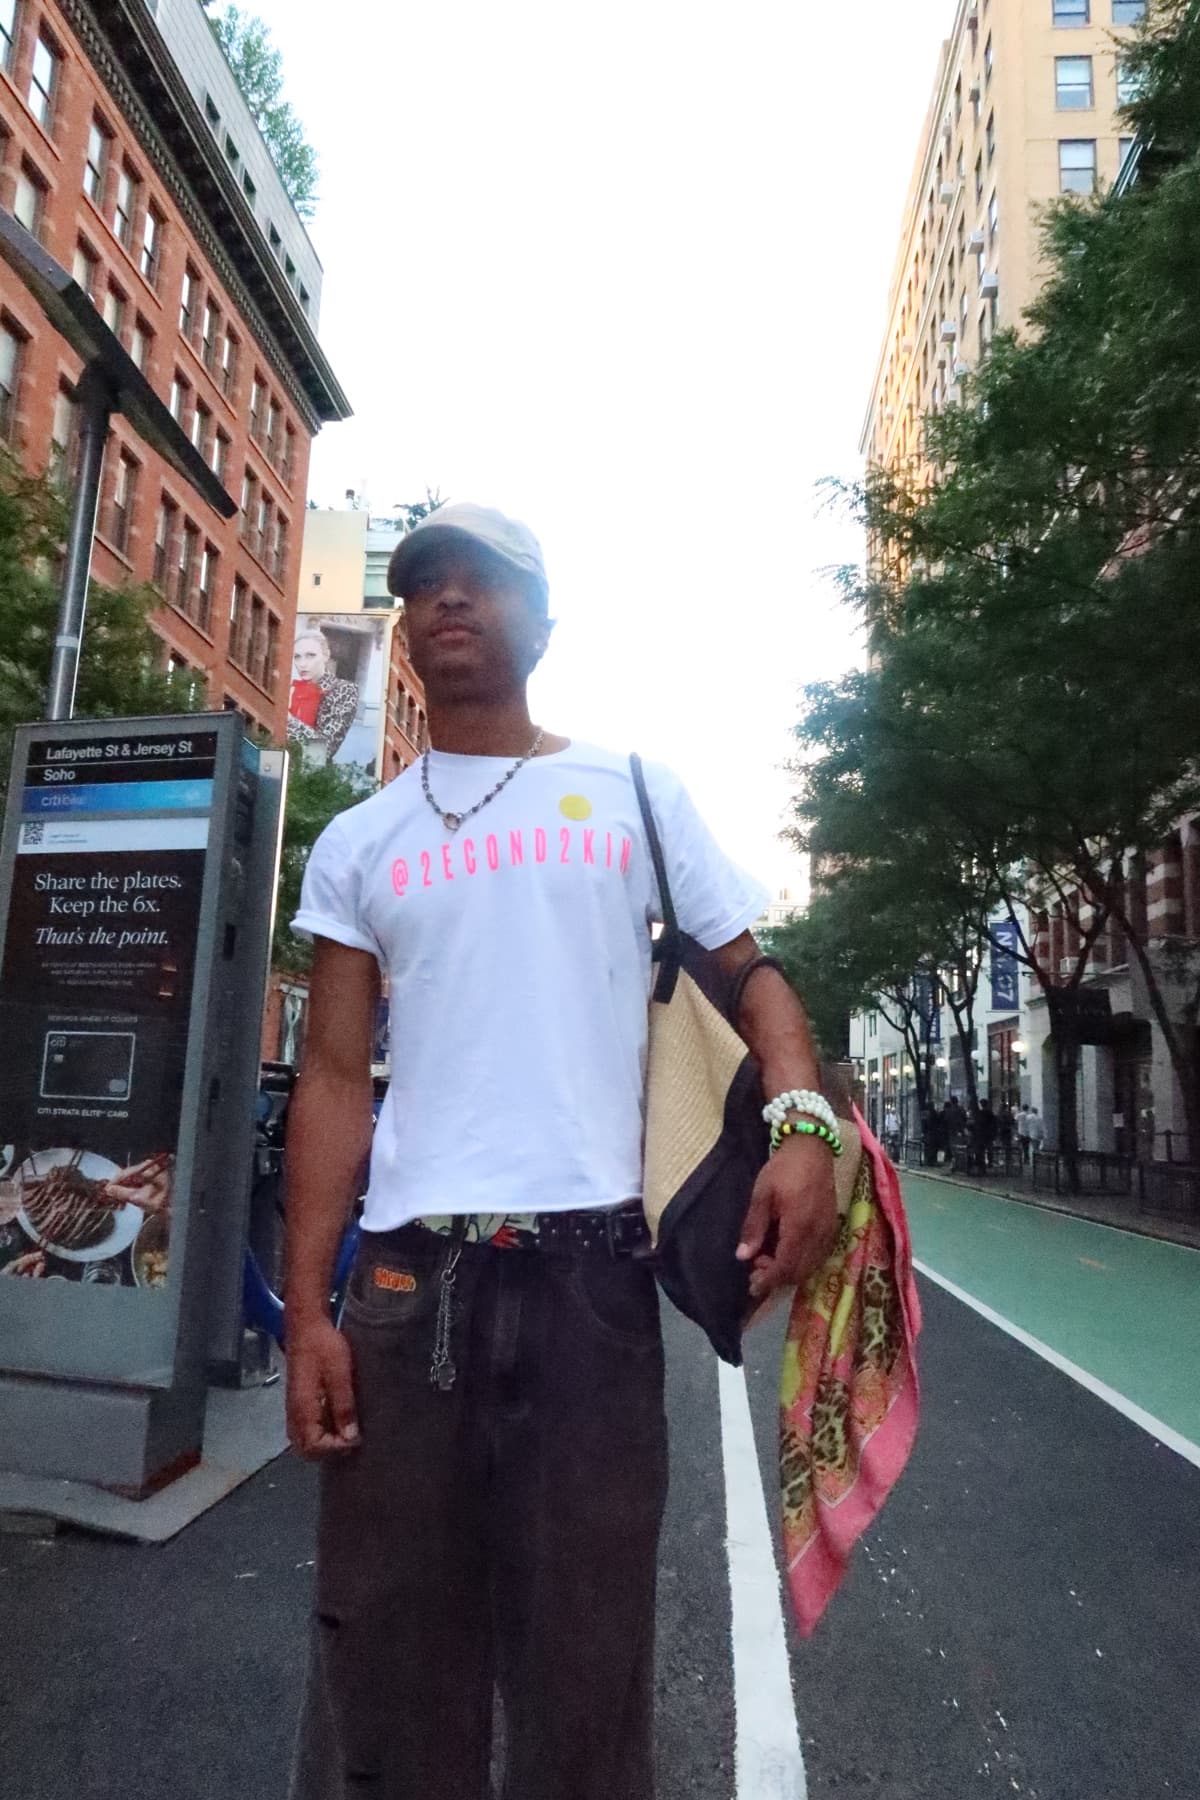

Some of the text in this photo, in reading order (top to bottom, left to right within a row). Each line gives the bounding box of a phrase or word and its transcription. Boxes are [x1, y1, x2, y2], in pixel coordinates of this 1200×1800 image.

[46, 741, 193, 760] Lafayette St & Jersey St
[43, 769, 76, 781] Soho
[34, 871, 182, 893] Share the plates.
[50, 896, 161, 917] Keep the 6x.
[35, 927, 169, 948] That's the point.
